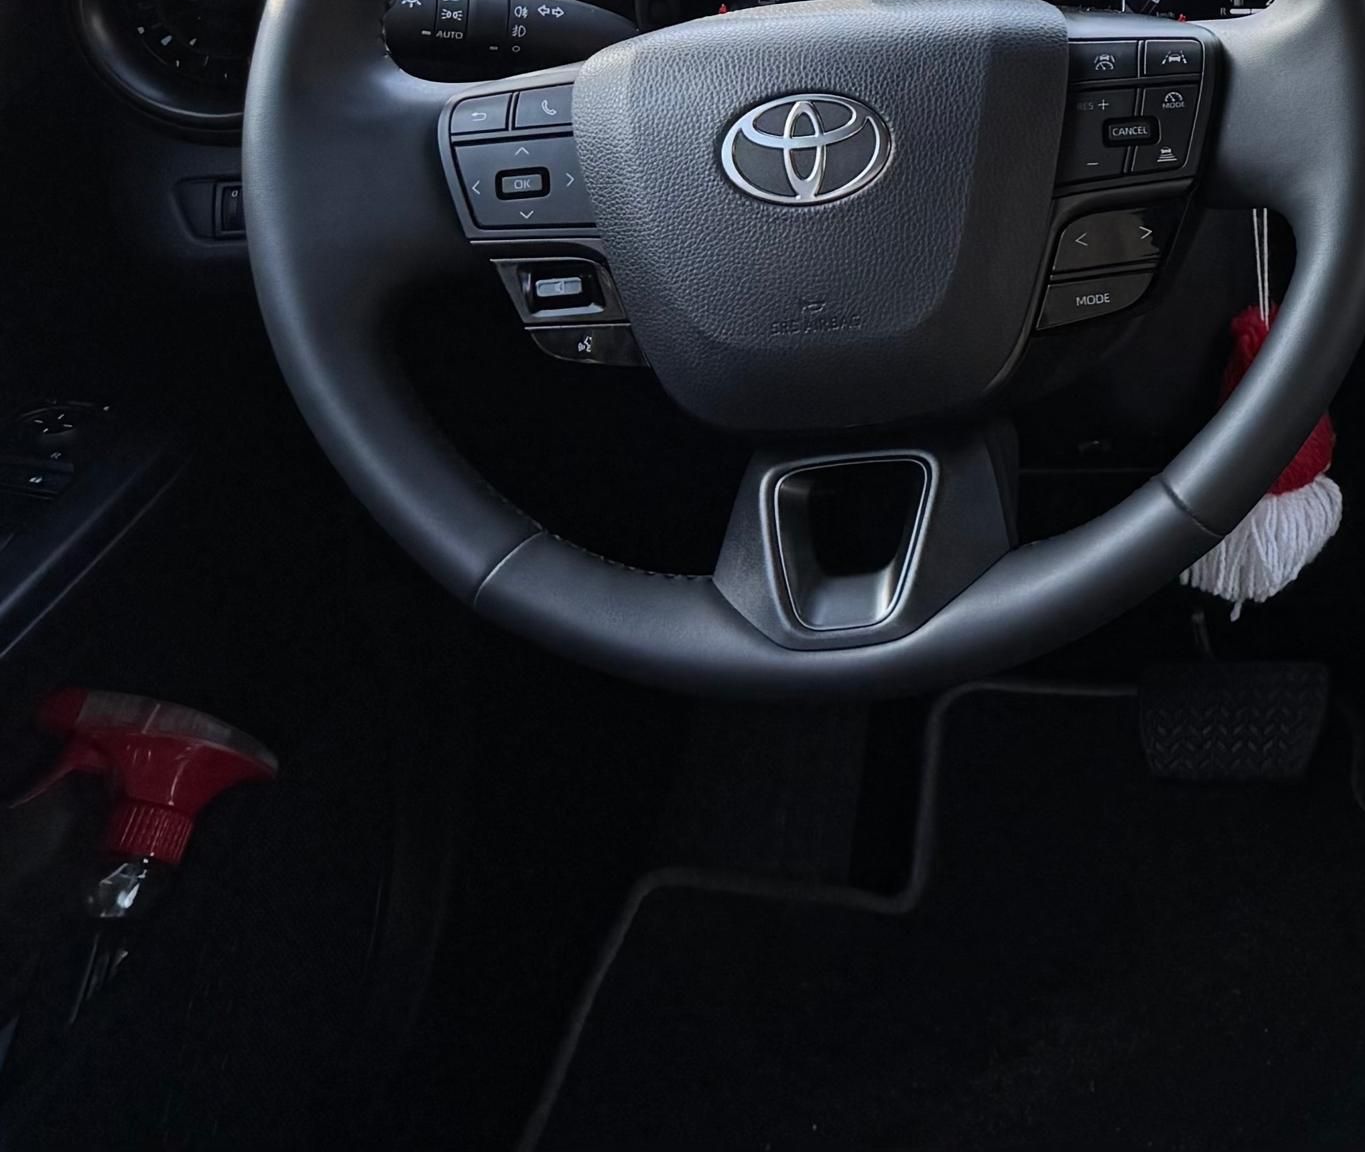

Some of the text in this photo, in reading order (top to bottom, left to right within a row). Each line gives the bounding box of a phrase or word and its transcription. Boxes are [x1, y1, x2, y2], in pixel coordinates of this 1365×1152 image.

[436, 31, 463, 39] AUTO
[1112, 126, 1148, 137] CANCEL
[513, 179, 531, 190] OK
[1076, 293, 1110, 306] MODE
